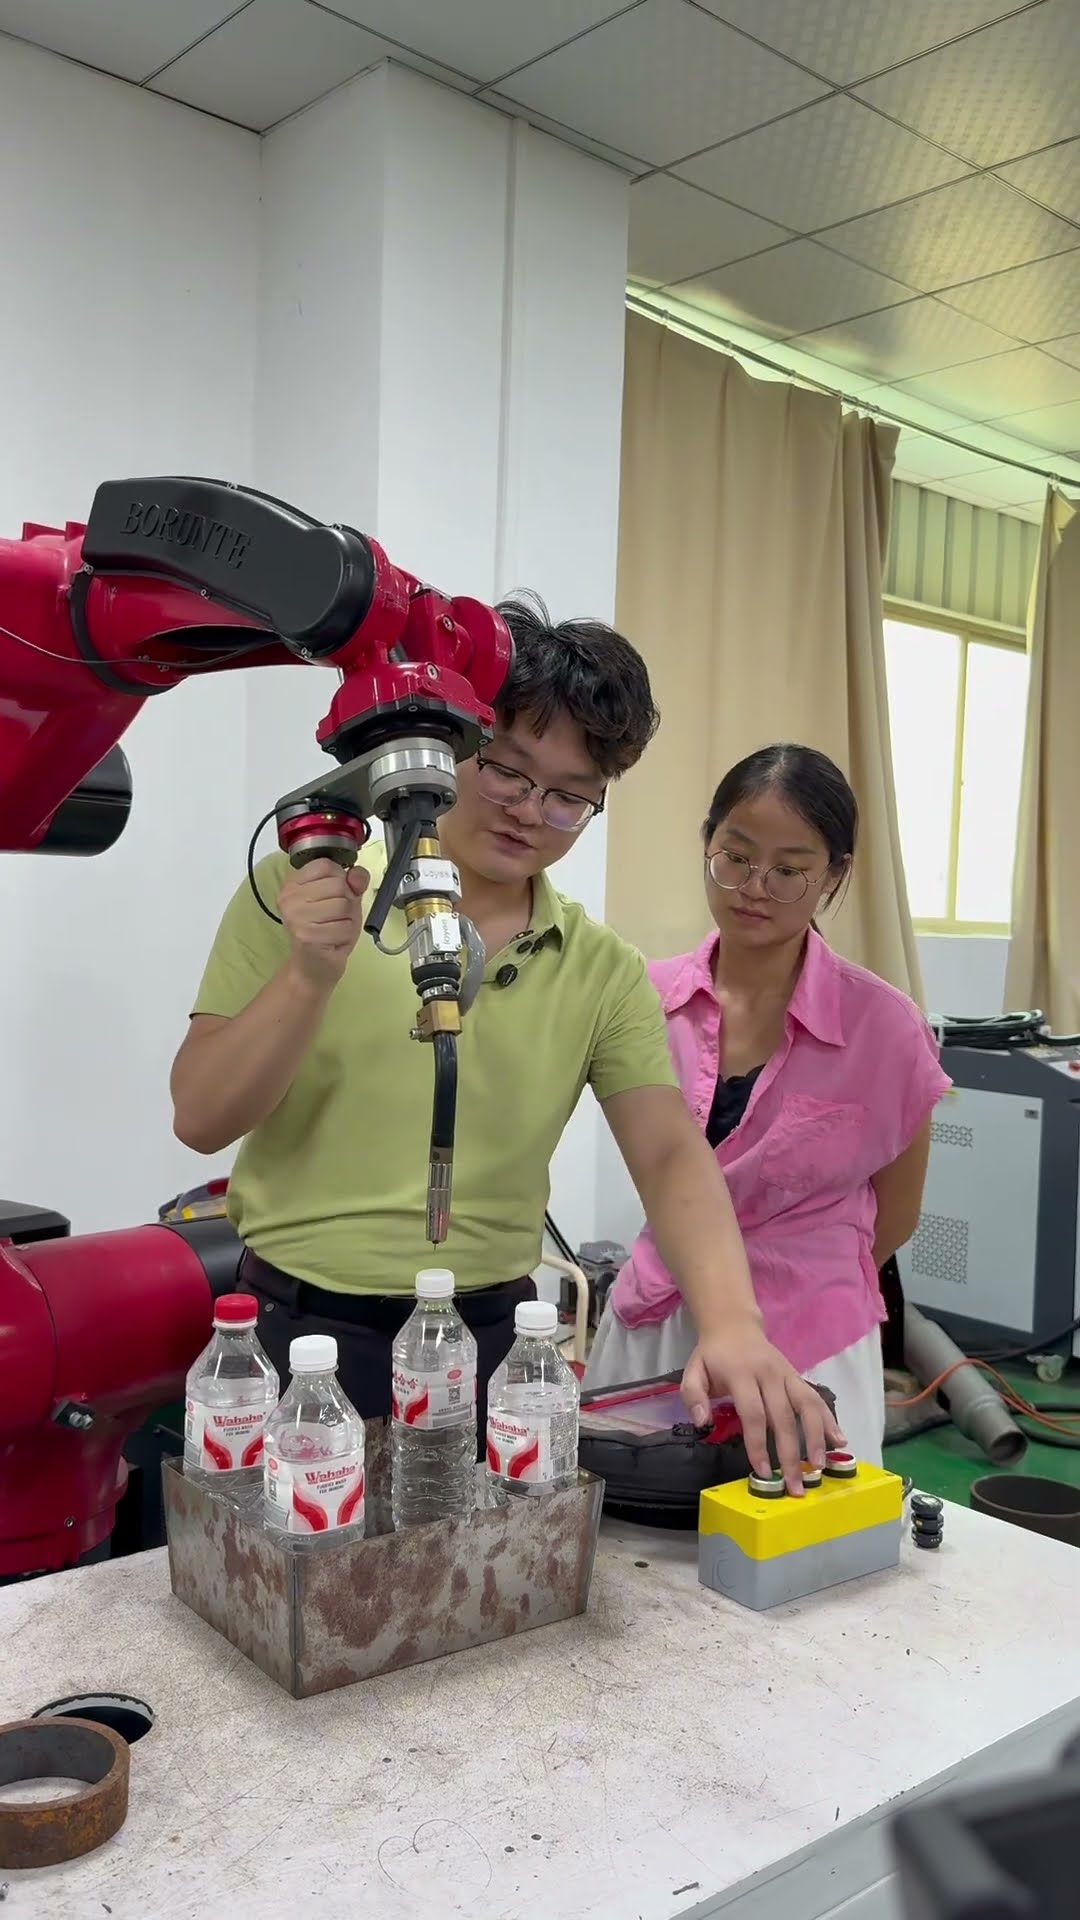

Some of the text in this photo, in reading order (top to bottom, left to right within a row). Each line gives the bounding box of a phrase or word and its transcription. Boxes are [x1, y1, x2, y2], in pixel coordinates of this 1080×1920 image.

[119, 502, 252, 568] BORUNTE
[213, 1414, 263, 1427] Wahaha
[489, 1415, 528, 1437] Wahaha
[305, 1465, 356, 1485] Wahaha
